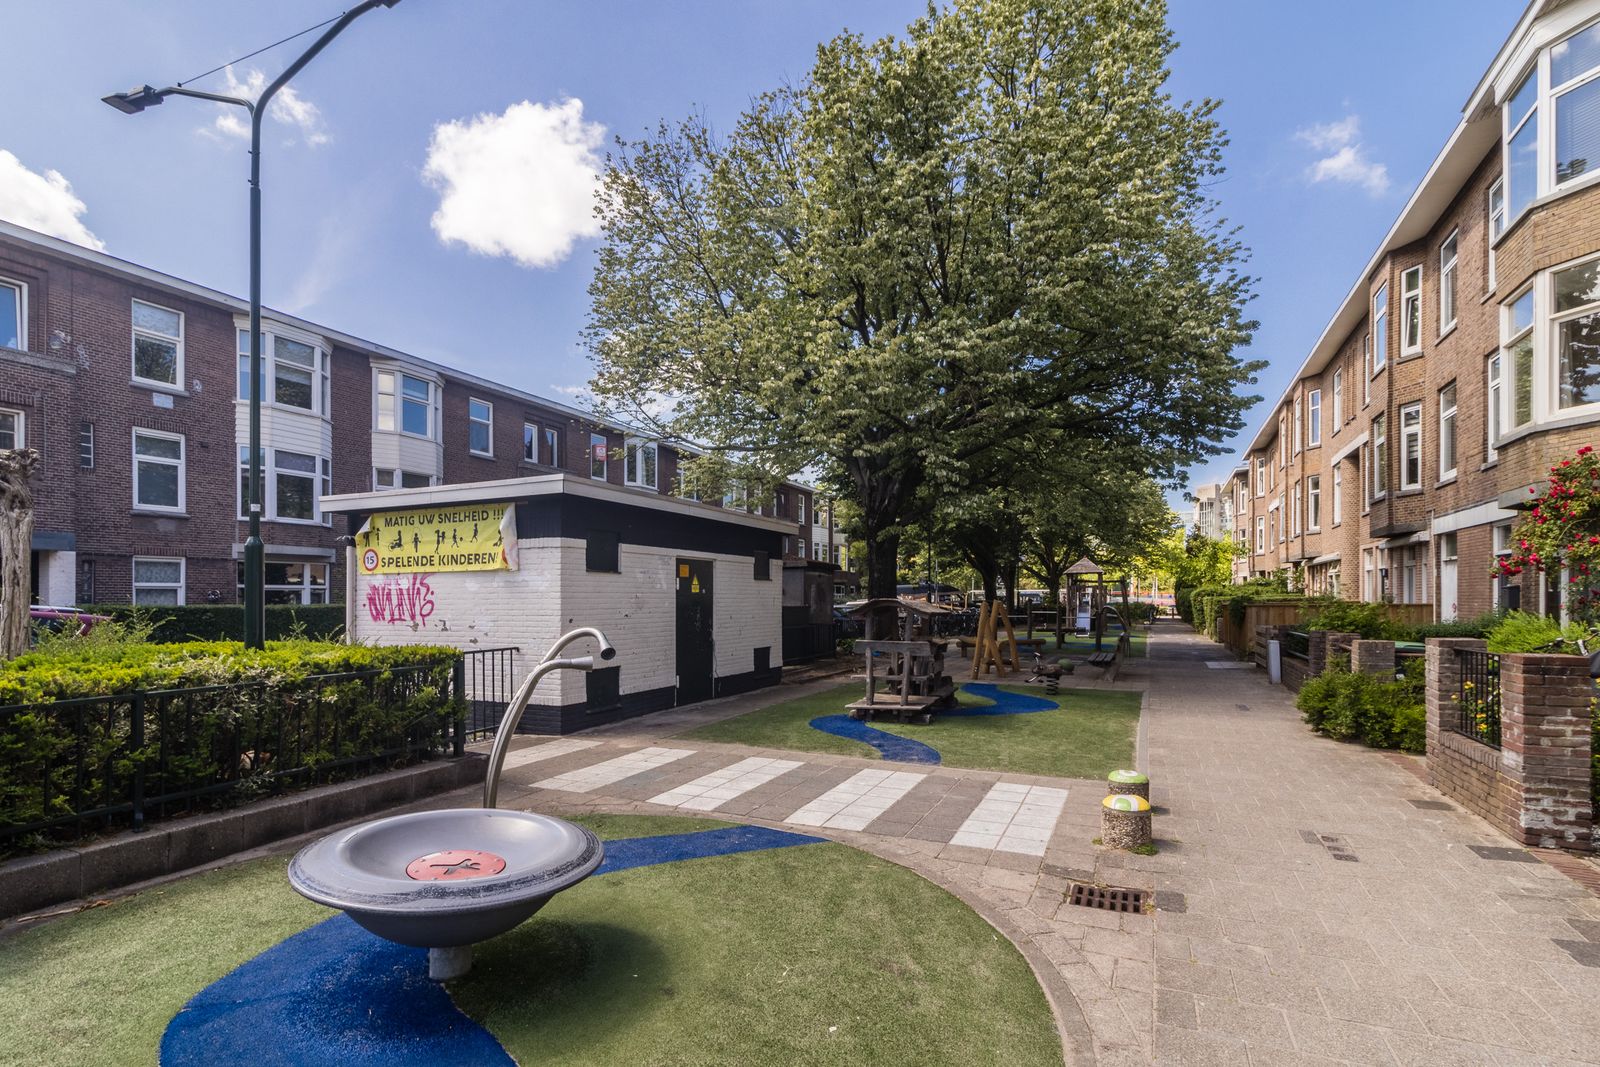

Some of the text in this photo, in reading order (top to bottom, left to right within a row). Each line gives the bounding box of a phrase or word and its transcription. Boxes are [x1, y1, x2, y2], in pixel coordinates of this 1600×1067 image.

[384, 515, 415, 528] MATIG
[418, 513, 436, 525] UW
[437, 509, 490, 524] SNELHEID
[366, 555, 375, 565] 15
[381, 554, 436, 568] SPELENDE
